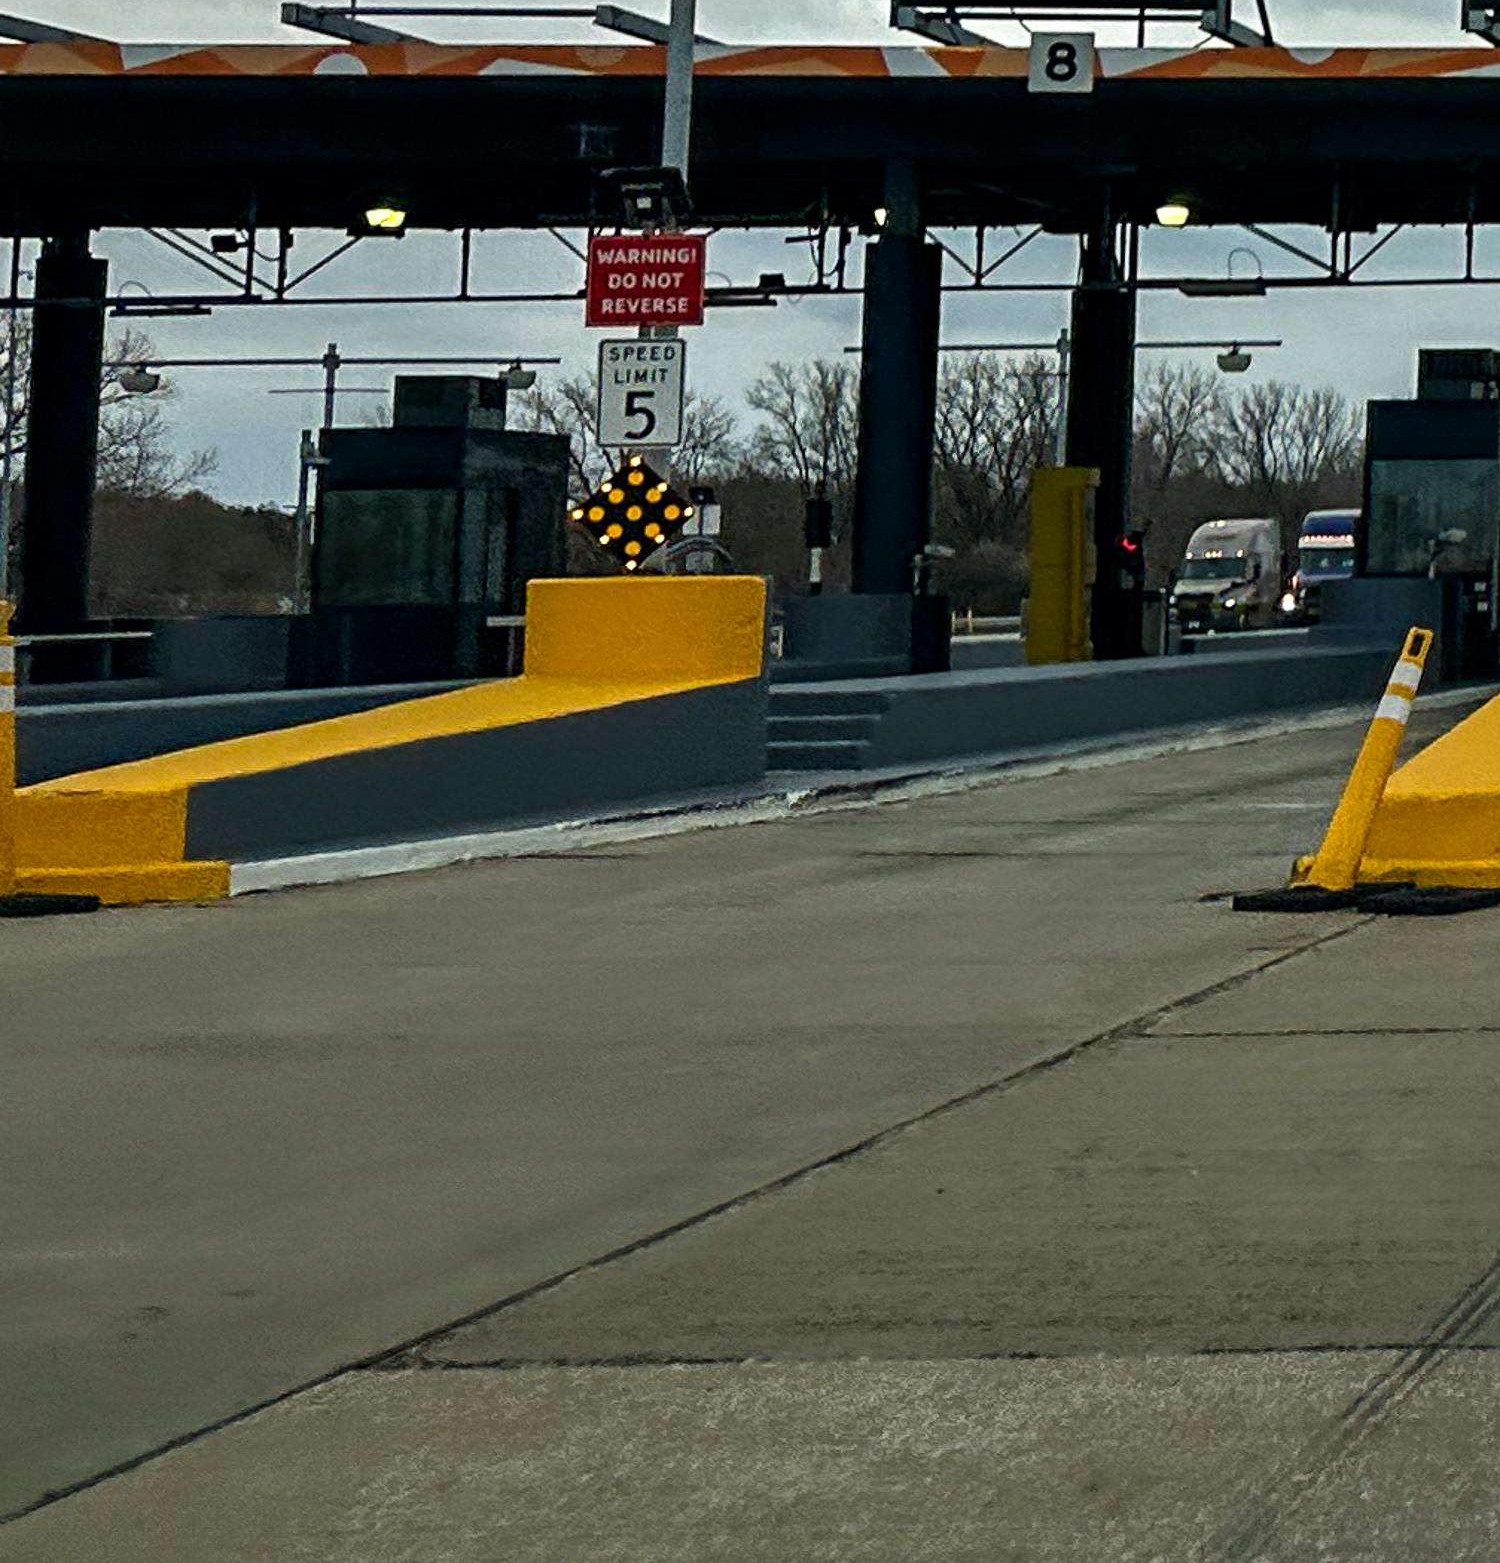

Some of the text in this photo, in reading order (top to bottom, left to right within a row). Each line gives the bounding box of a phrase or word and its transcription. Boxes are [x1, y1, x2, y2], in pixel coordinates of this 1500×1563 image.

[1045, 41, 1078, 82] 8
[596, 247, 697, 264] WARNING!
[607, 272, 685, 289] DO NOT
[601, 297, 689, 314] REVERSE
[608, 345, 676, 362] SPEED
[613, 368, 669, 385] LIMIT
[624, 390, 656, 440] 5
